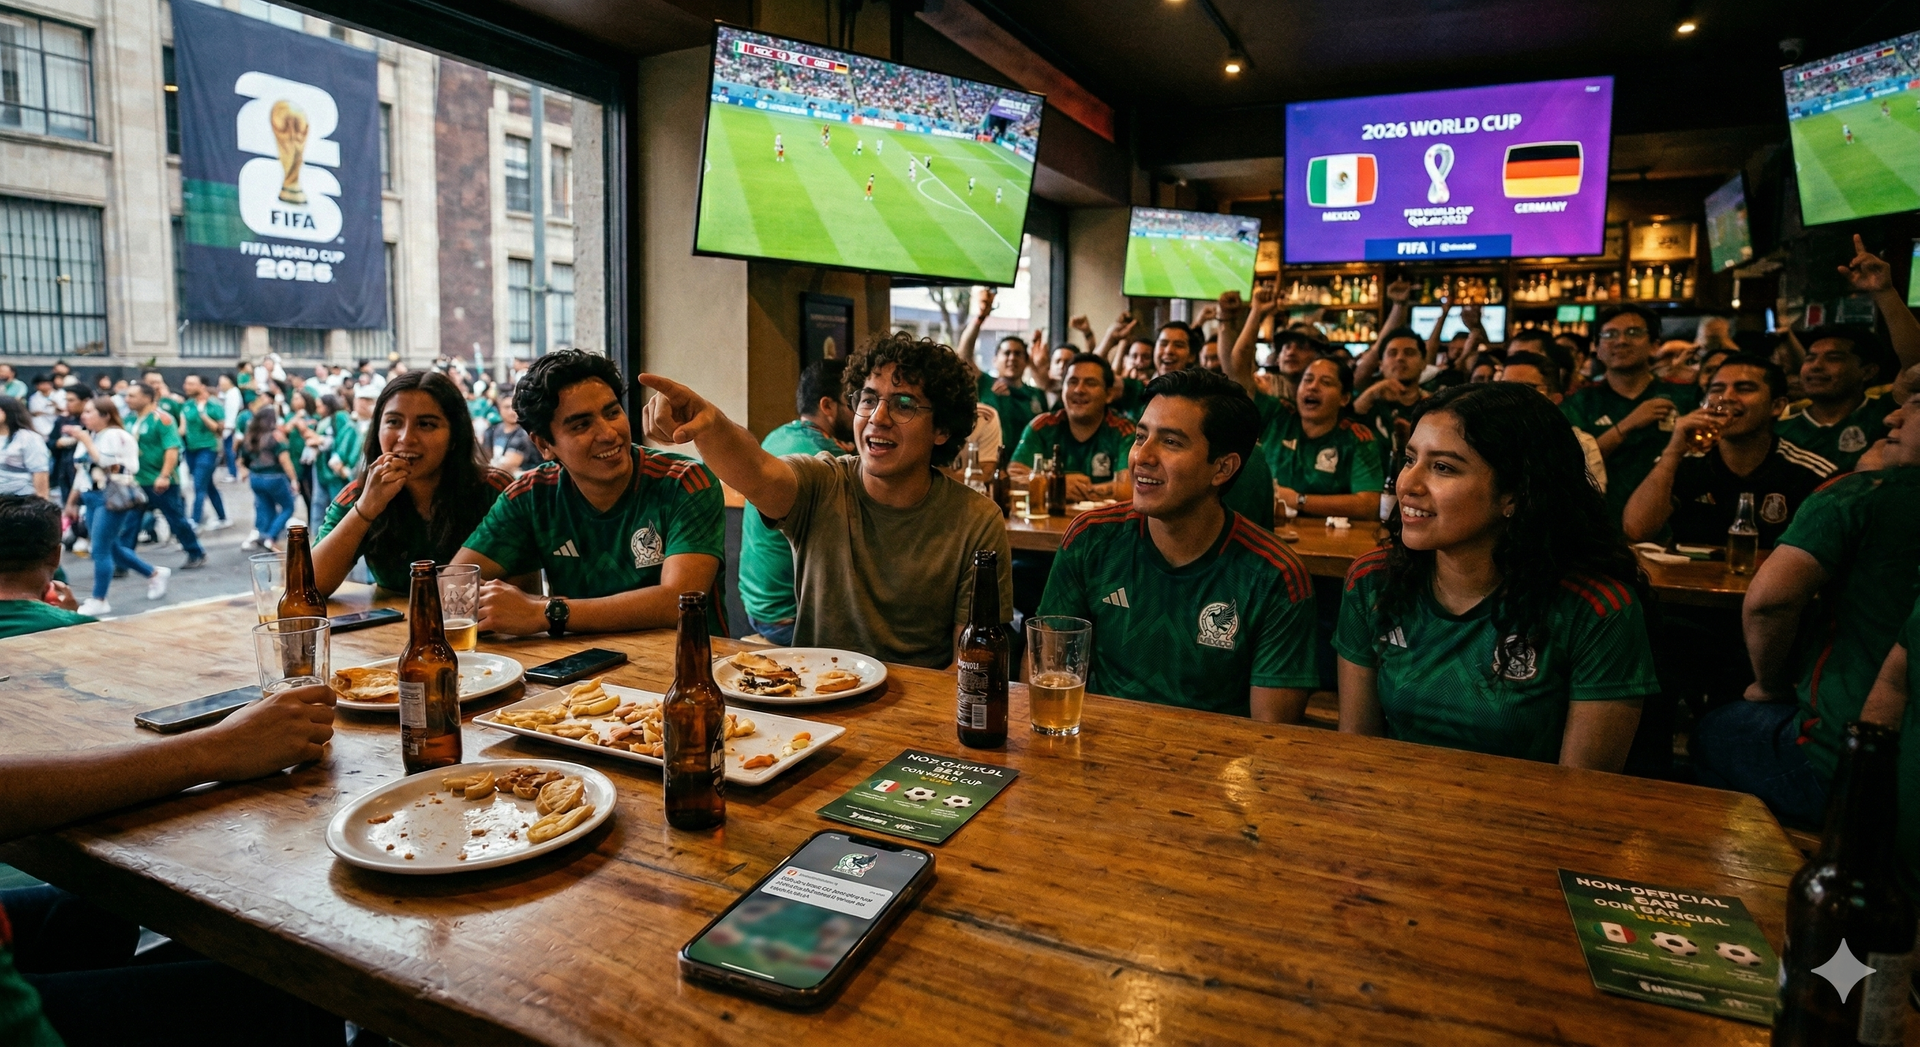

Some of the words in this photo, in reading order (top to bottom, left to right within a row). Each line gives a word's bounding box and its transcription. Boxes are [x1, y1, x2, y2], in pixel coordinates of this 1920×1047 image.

[1361, 122, 1408, 140] 2026
[1410, 116, 1479, 137] WORLD
[1481, 113, 1522, 131] CUP
[1322, 210, 1360, 222] MEXICO
[1514, 201, 1567, 214] GERMANY
[271, 210, 316, 230] FIFA
[240, 241, 272, 258] FIFA
[271, 244, 319, 262] WORLD
[320, 249, 345, 264] CUP
[1397, 241, 1429, 255] FIFA
[255, 257, 334, 284] 2026
[959, 778, 983, 787] CUP
[1575, 877, 1730, 909] NON-OFFICIAL
